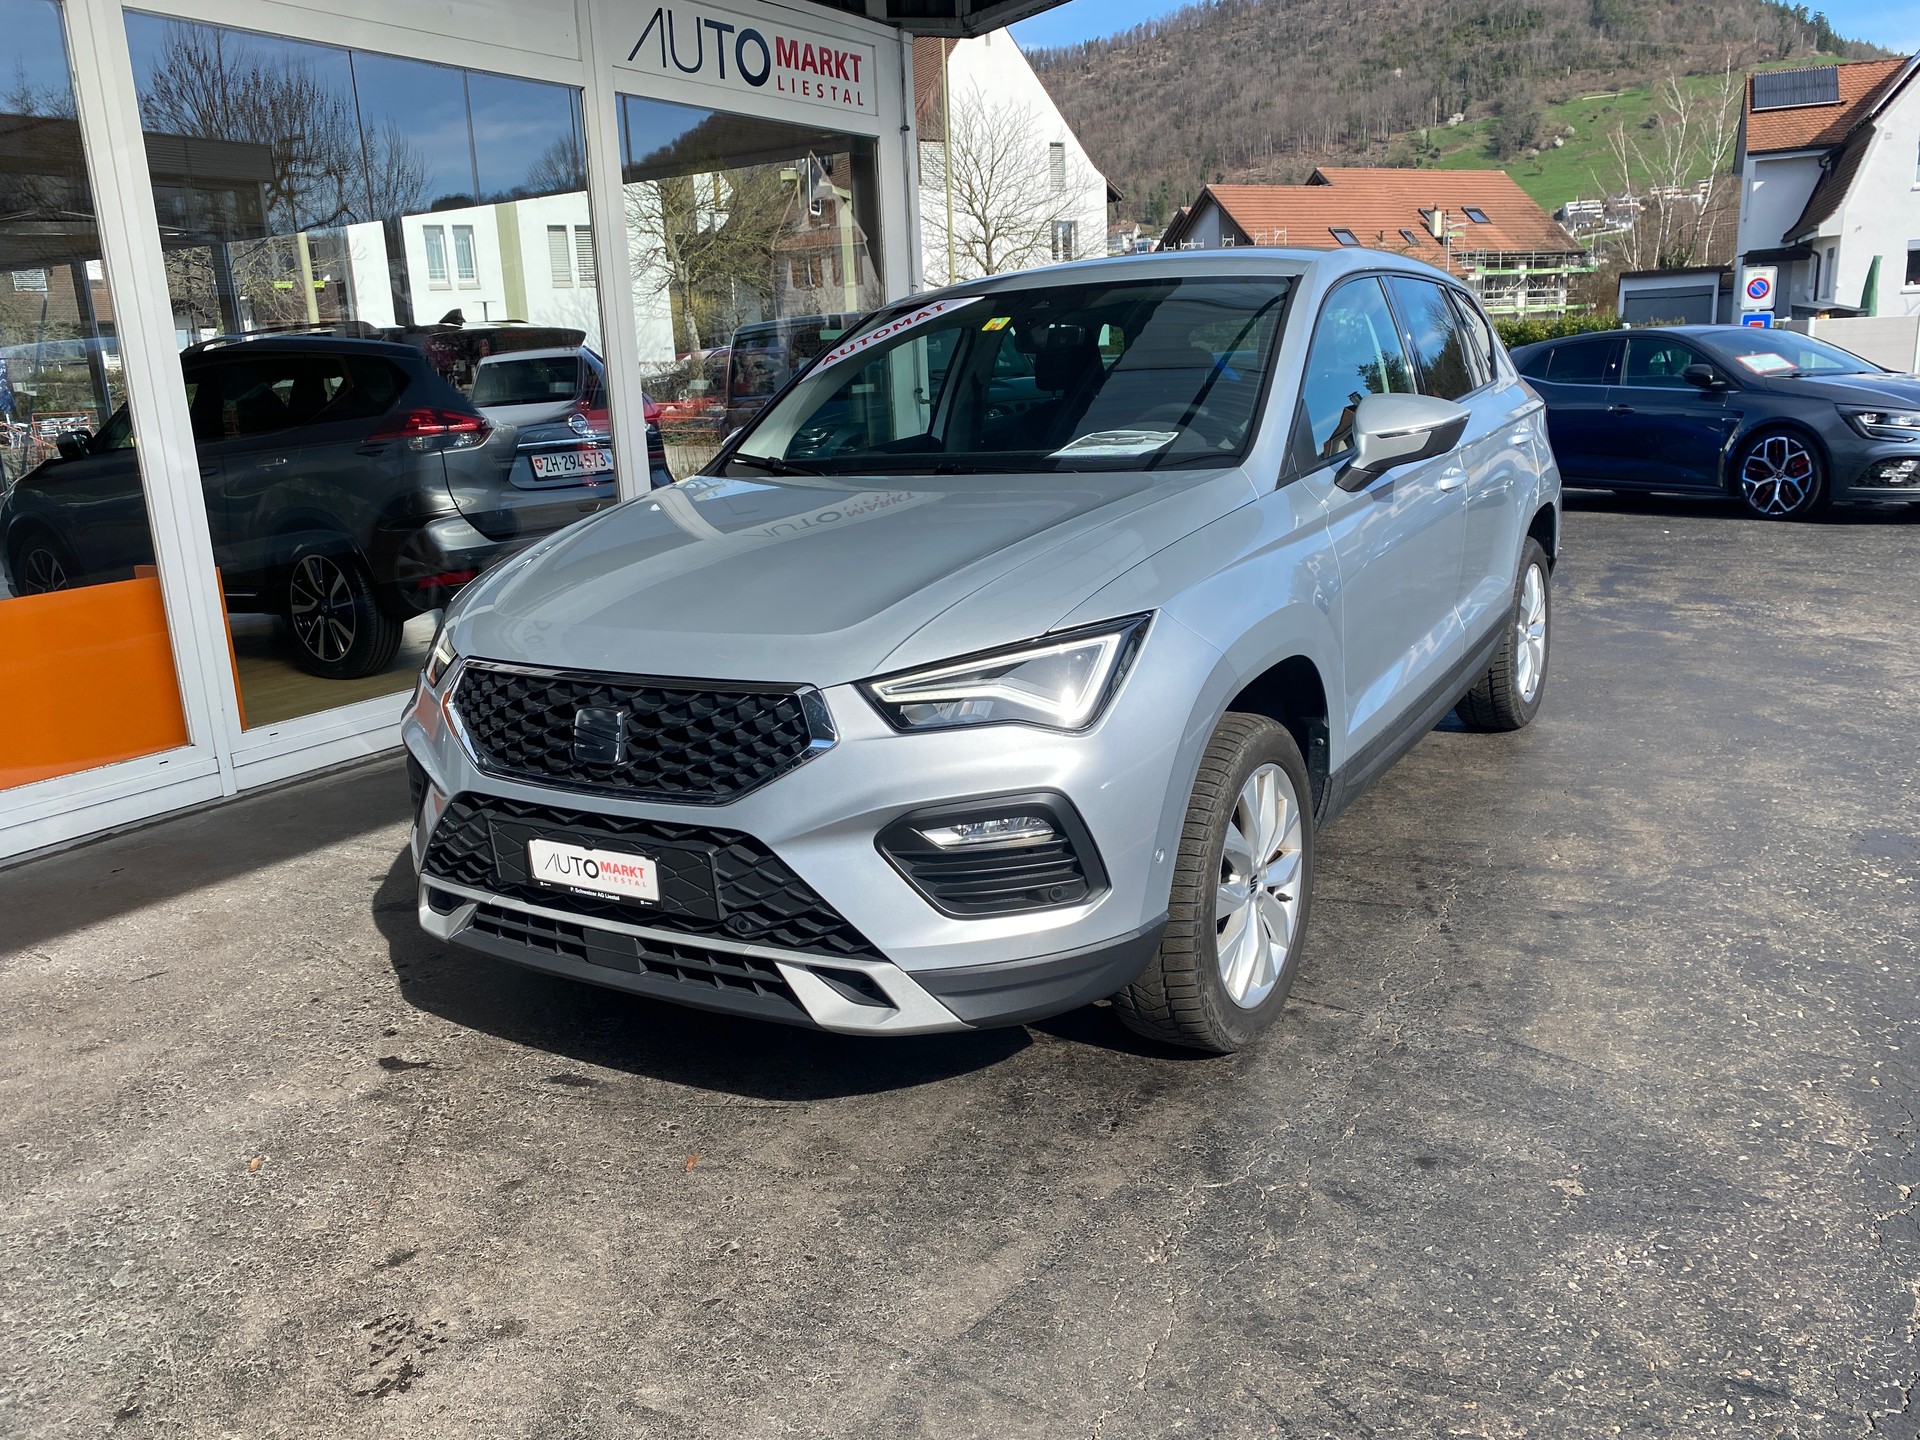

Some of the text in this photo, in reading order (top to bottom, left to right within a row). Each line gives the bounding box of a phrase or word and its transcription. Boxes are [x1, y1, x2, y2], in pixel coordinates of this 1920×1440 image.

[775, 36, 862, 83] MARKT
[777, 75, 864, 107] LIESTAL
[822, 302, 946, 366] AUTOMAT
[600, 861, 645, 879] MARKT
[602, 875, 647, 888] LIESTAL
